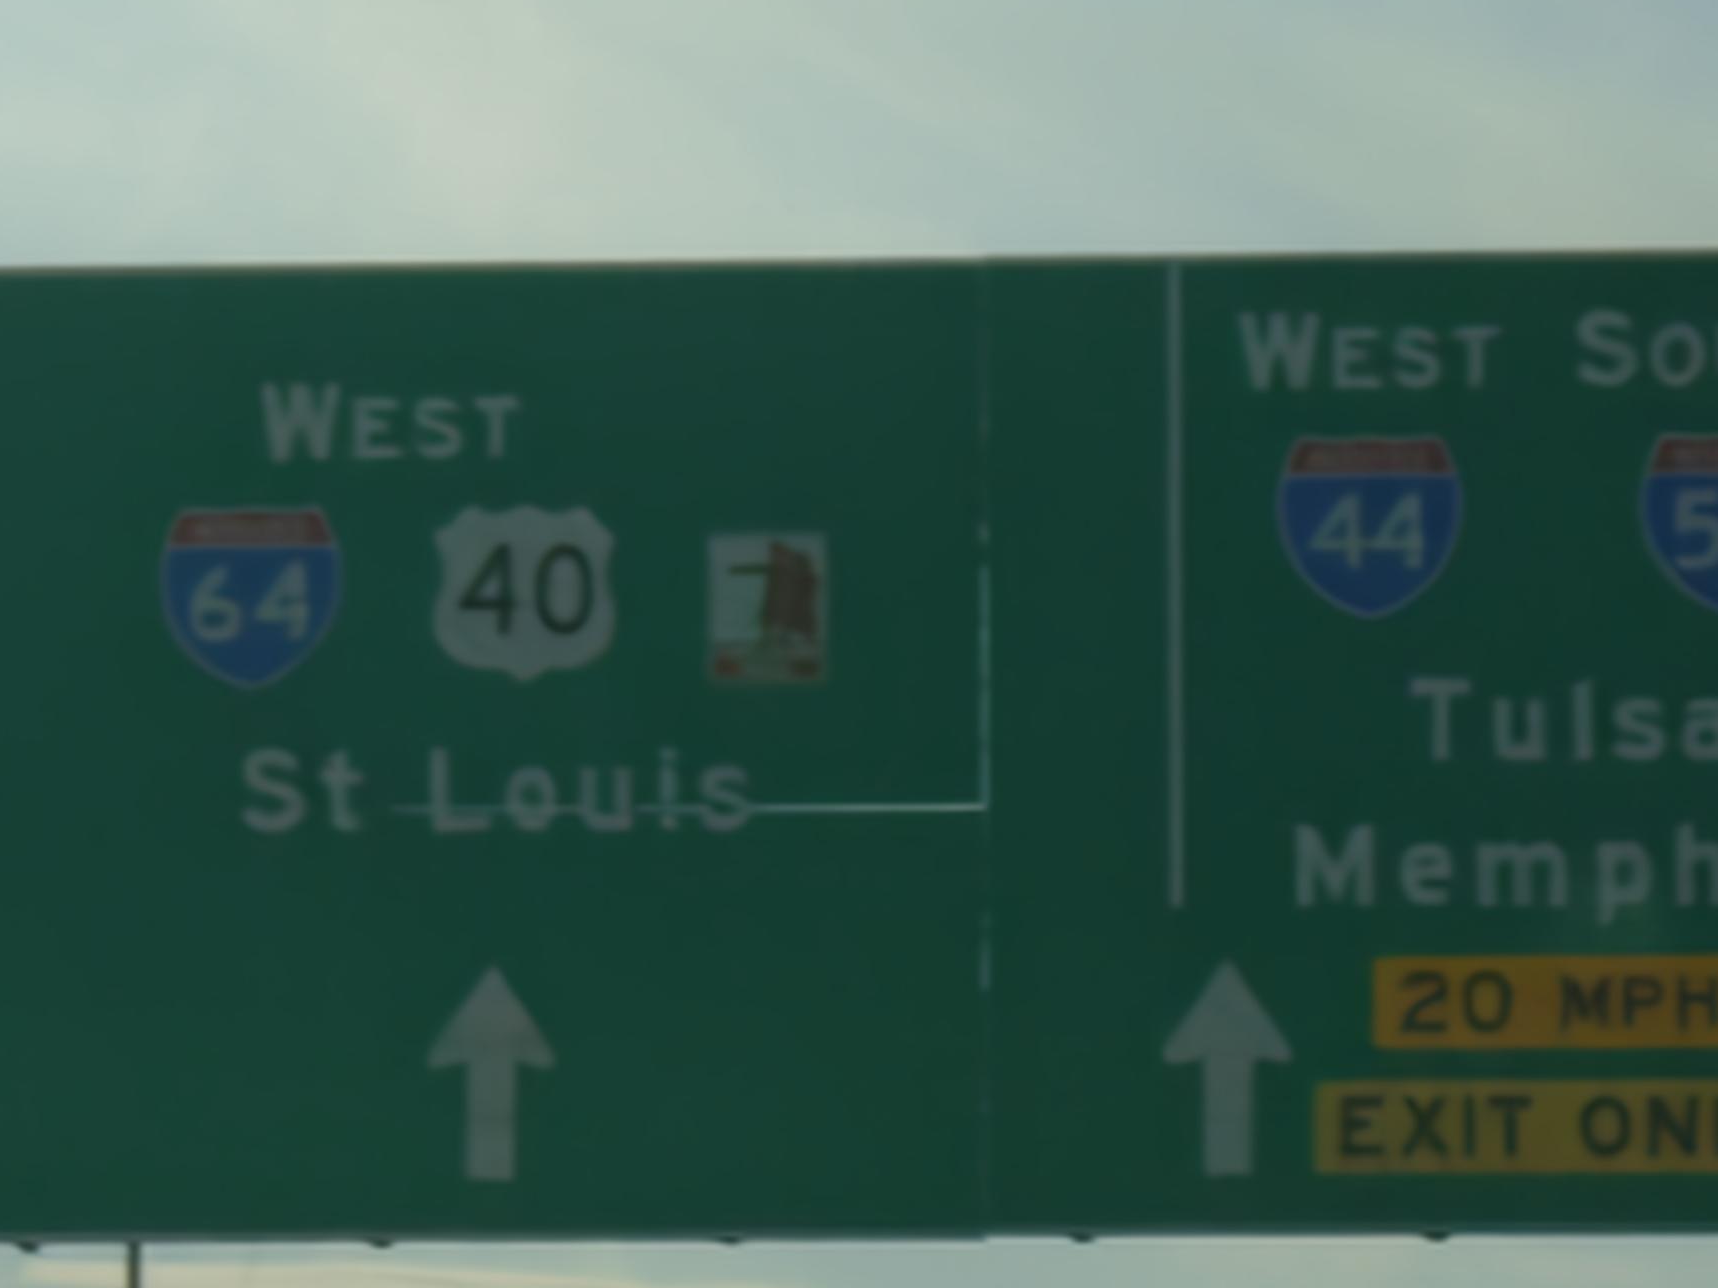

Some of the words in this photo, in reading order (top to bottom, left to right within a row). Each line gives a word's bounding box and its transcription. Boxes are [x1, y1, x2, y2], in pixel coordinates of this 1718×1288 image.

[1237, 311, 1502, 390] WEST
[260, 381, 520, 462] WEST
[1308, 492, 1425, 570] 44
[188, 561, 310, 643] 64
[457, 542, 594, 638] 40
[240, 746, 364, 834] St
[428, 746, 753, 834] Louis
[1400, 970, 1514, 1035] 20
[1337, 1094, 1534, 1159] EXIT
